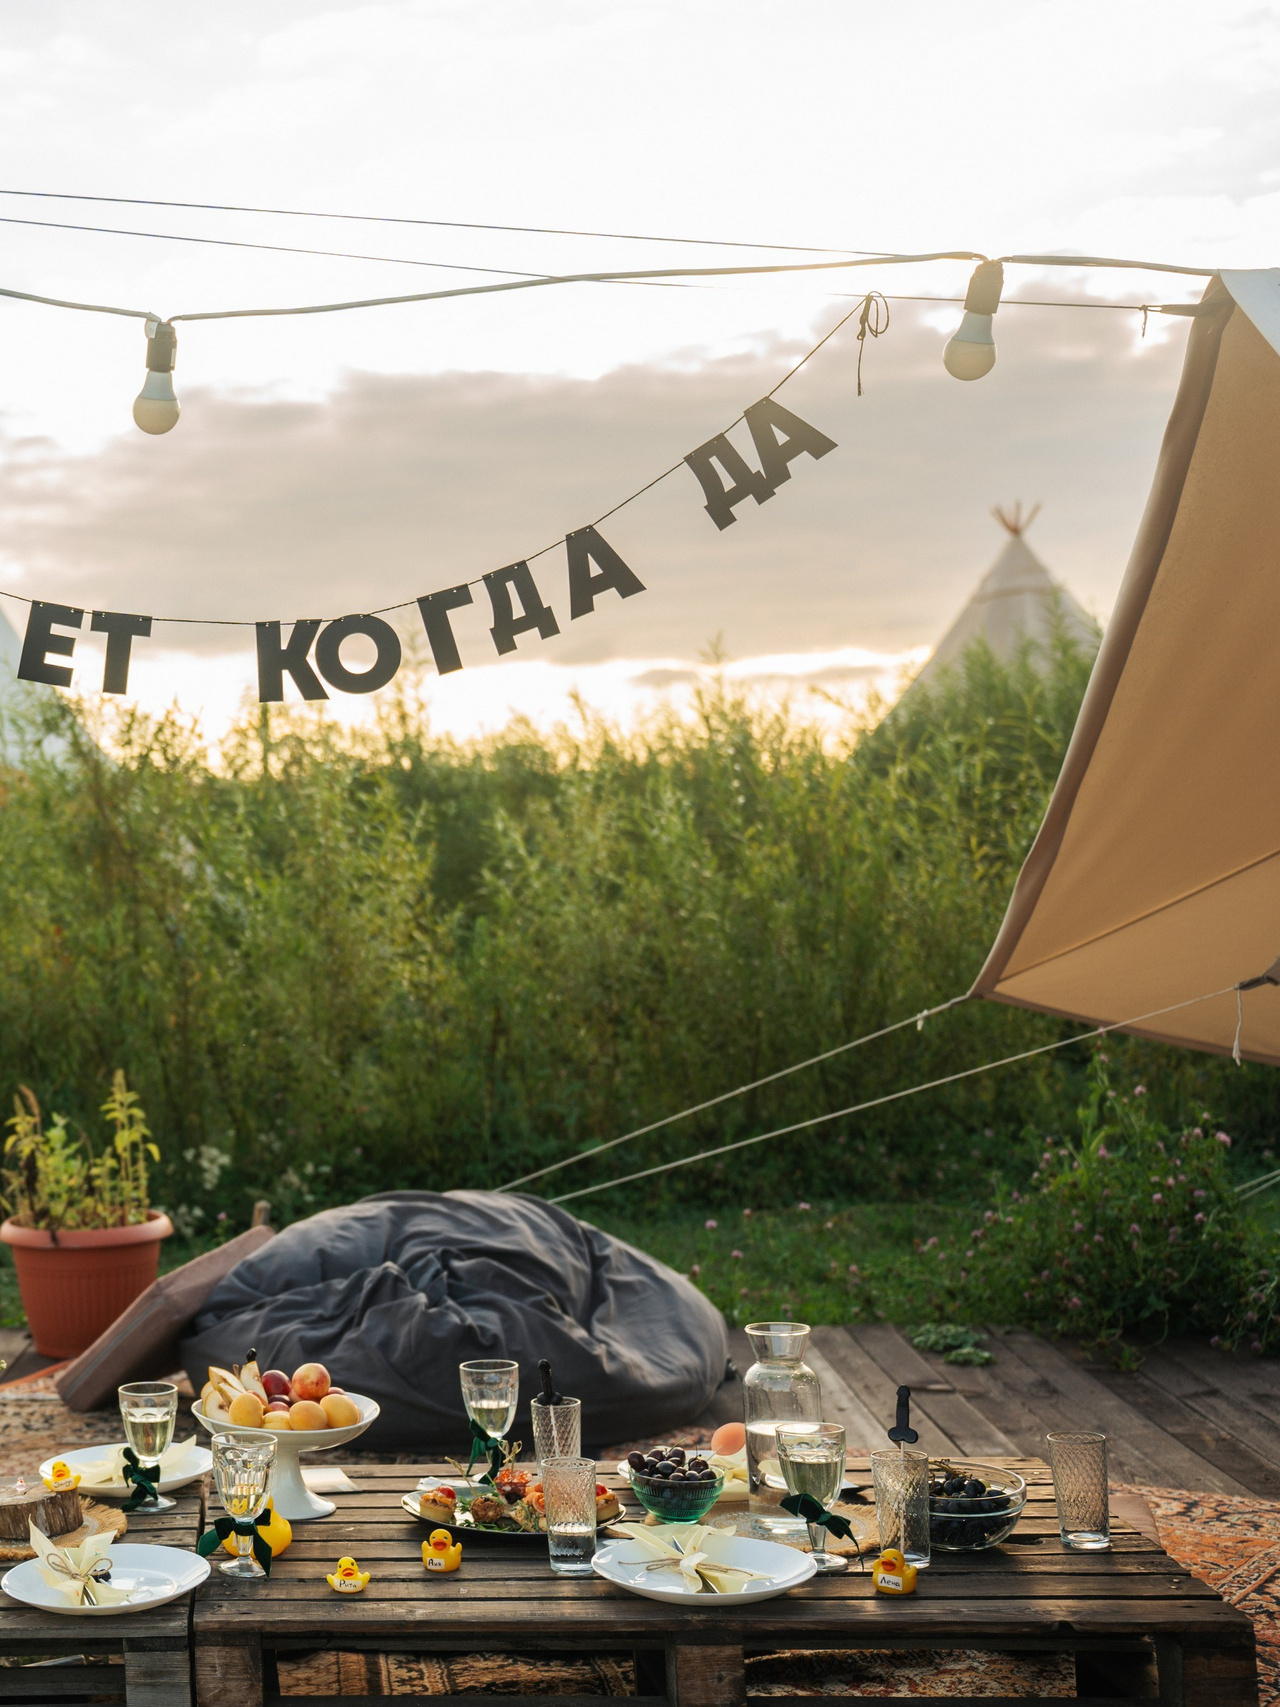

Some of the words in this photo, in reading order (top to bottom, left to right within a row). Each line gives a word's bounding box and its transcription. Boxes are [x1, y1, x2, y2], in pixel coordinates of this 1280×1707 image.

[255, 524, 647, 703] КОГДА
[683, 396, 839, 531] ДА
[339, 1579, 357, 1588] Рита
[880, 1576, 901, 1587] Лена
